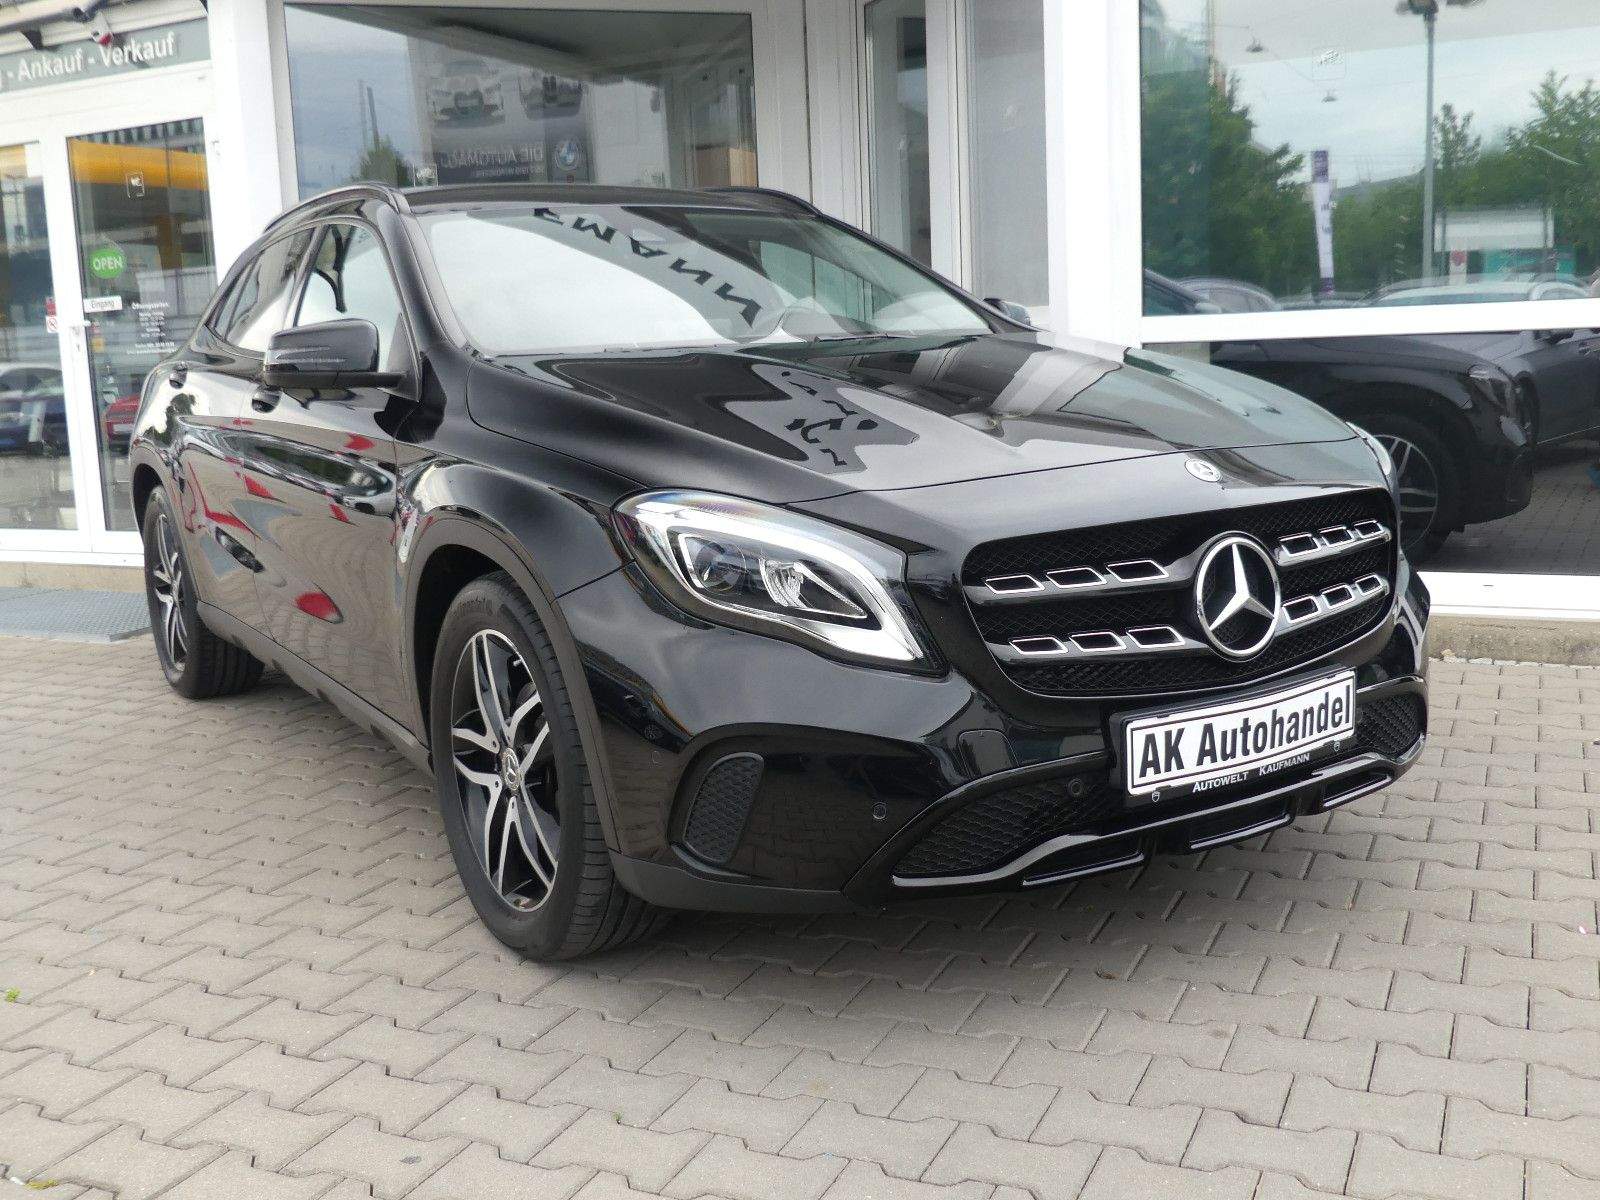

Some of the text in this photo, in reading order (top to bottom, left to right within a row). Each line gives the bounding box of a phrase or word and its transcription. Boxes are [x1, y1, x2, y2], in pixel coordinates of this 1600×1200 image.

[17, 47, 83, 81] Ankauf
[99, 31, 175, 68] Verkauf
[92, 256, 124, 271] OPEN
[1138, 684, 1352, 779] AK Autohandel
[1192, 752, 1310, 793] AUTOWELT KAUFMANN
